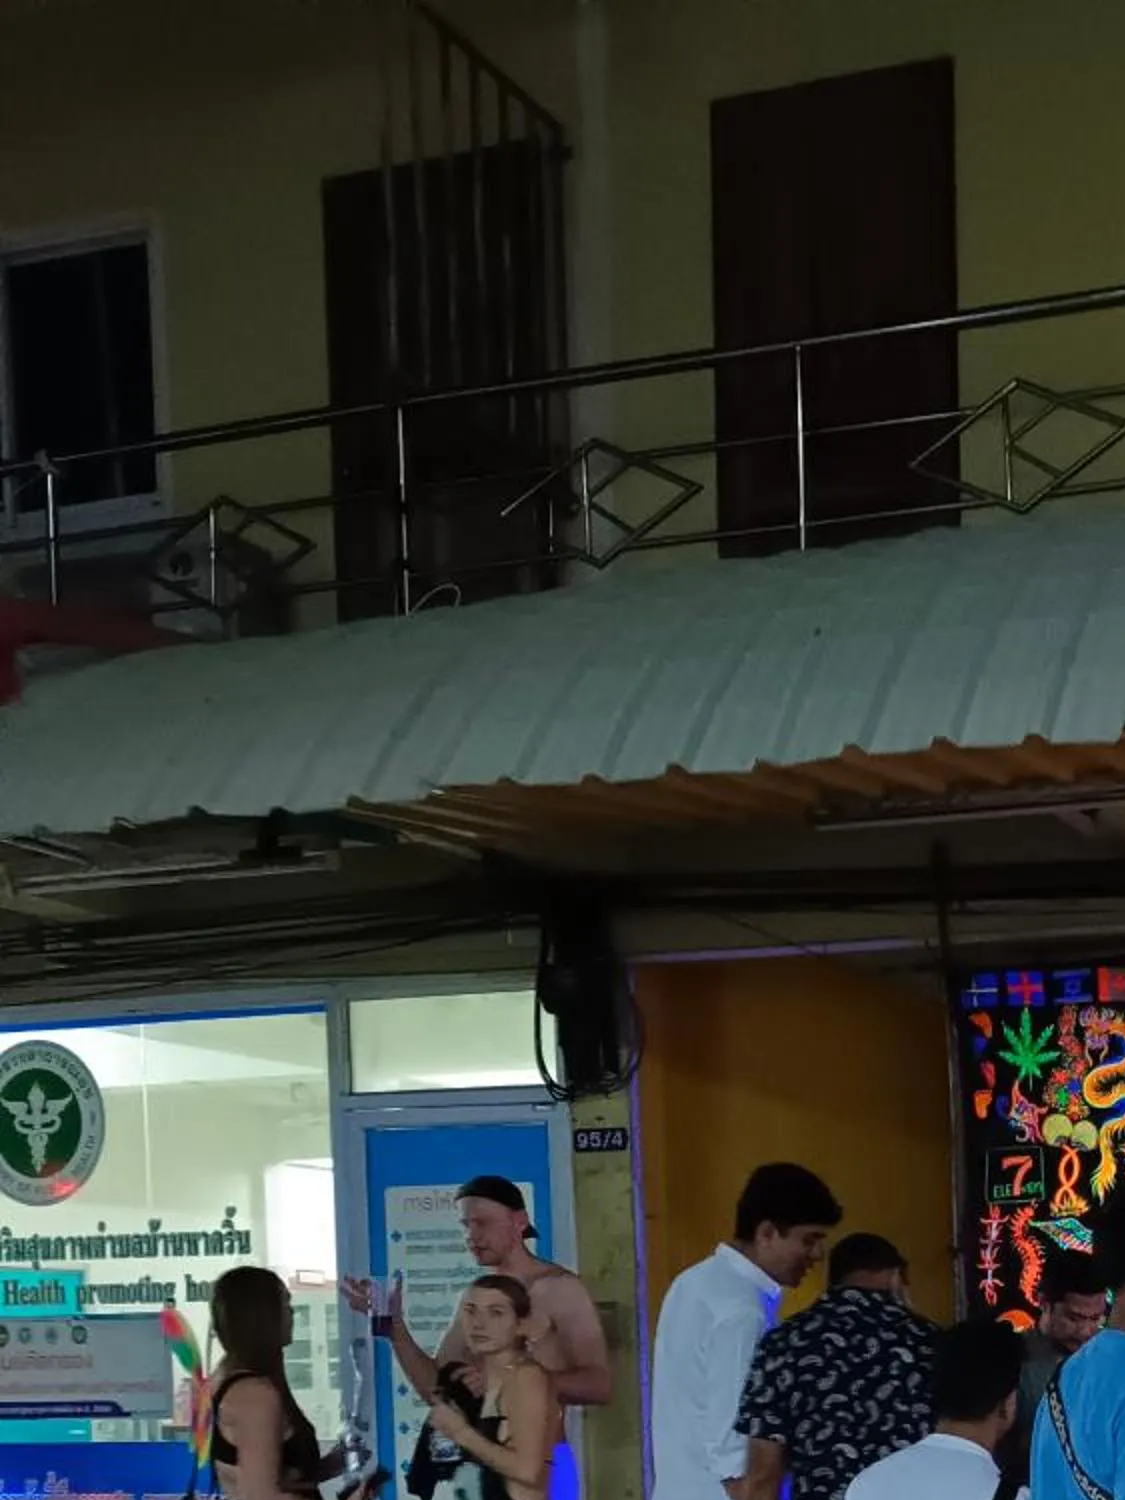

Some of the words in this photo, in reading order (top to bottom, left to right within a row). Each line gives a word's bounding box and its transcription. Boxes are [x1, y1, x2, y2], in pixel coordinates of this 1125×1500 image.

[577, 1131, 623, 1148] 95/4
[1001, 1155, 1033, 1196] 7
[3, 1278, 65, 1305] Health
[76, 1274, 176, 1312] promoting
